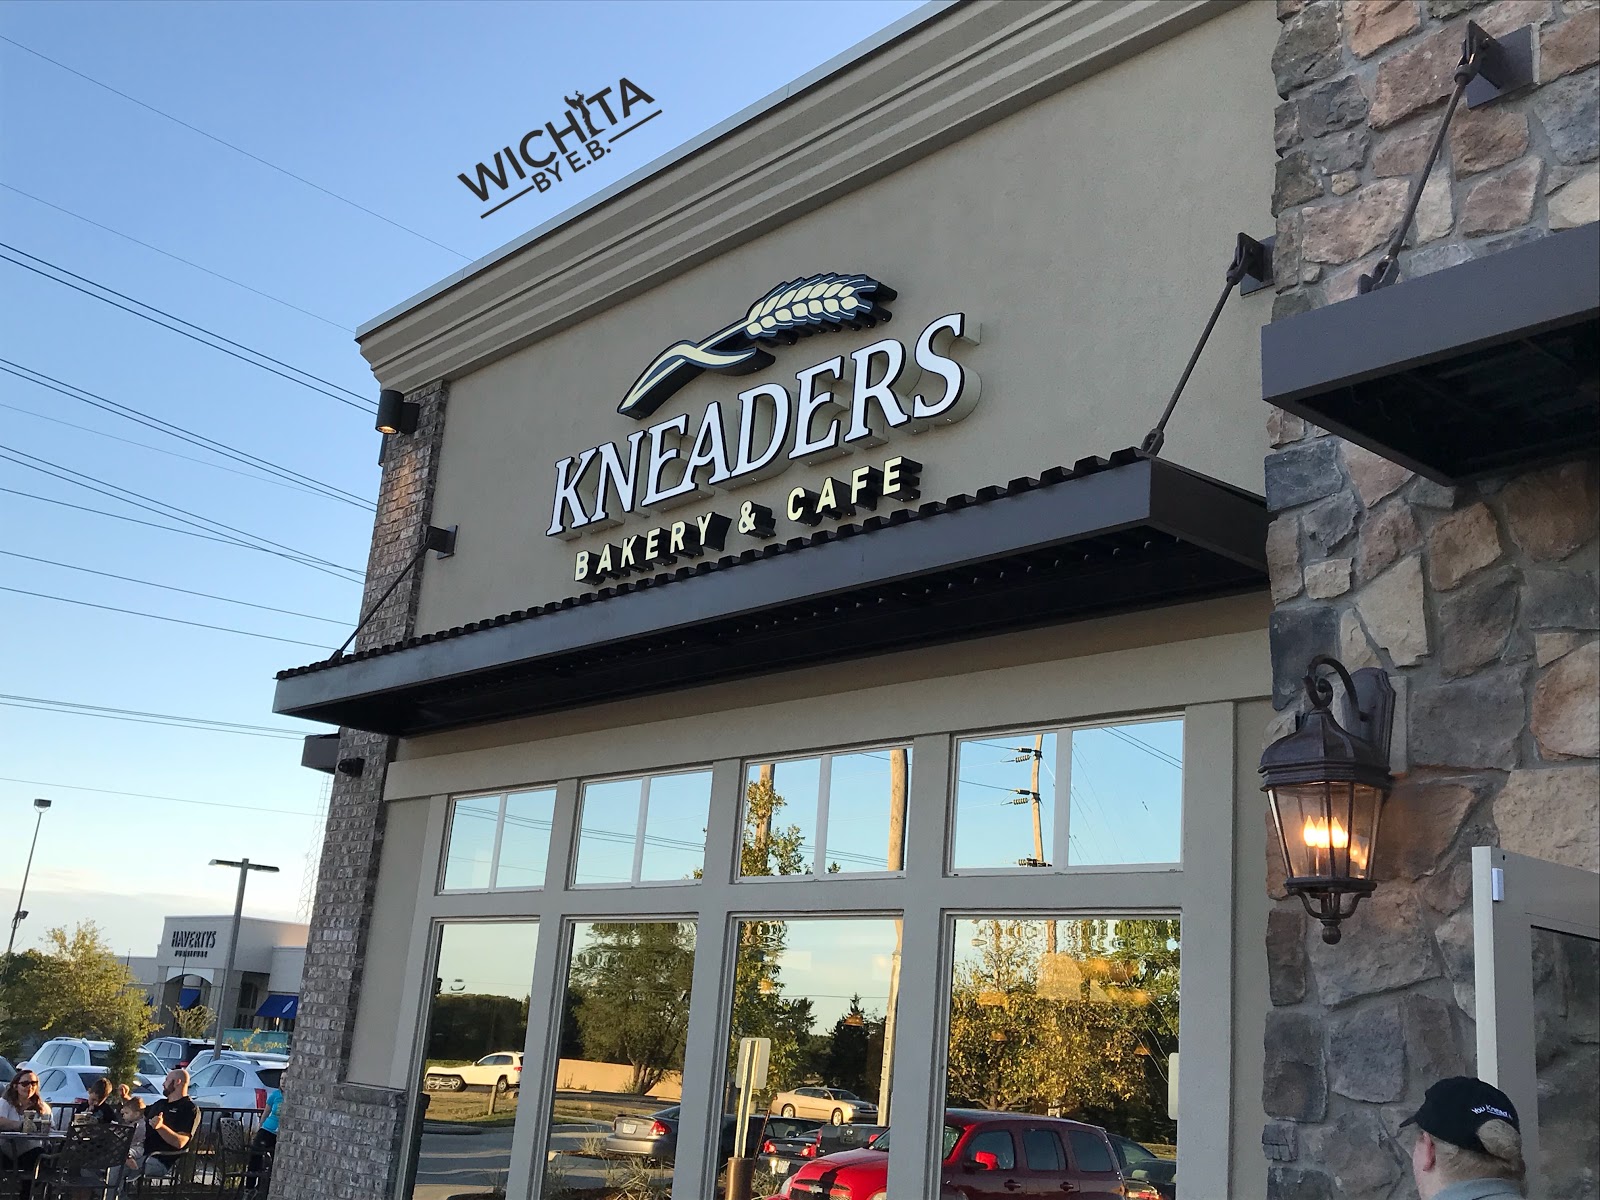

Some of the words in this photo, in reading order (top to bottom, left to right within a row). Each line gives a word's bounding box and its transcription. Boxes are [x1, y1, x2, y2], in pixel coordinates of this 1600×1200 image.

[545, 312, 966, 538] KNEADERS
[574, 512, 716, 583] BAKERY
[737, 500, 757, 535] &
[786, 456, 904, 523] CAFE
